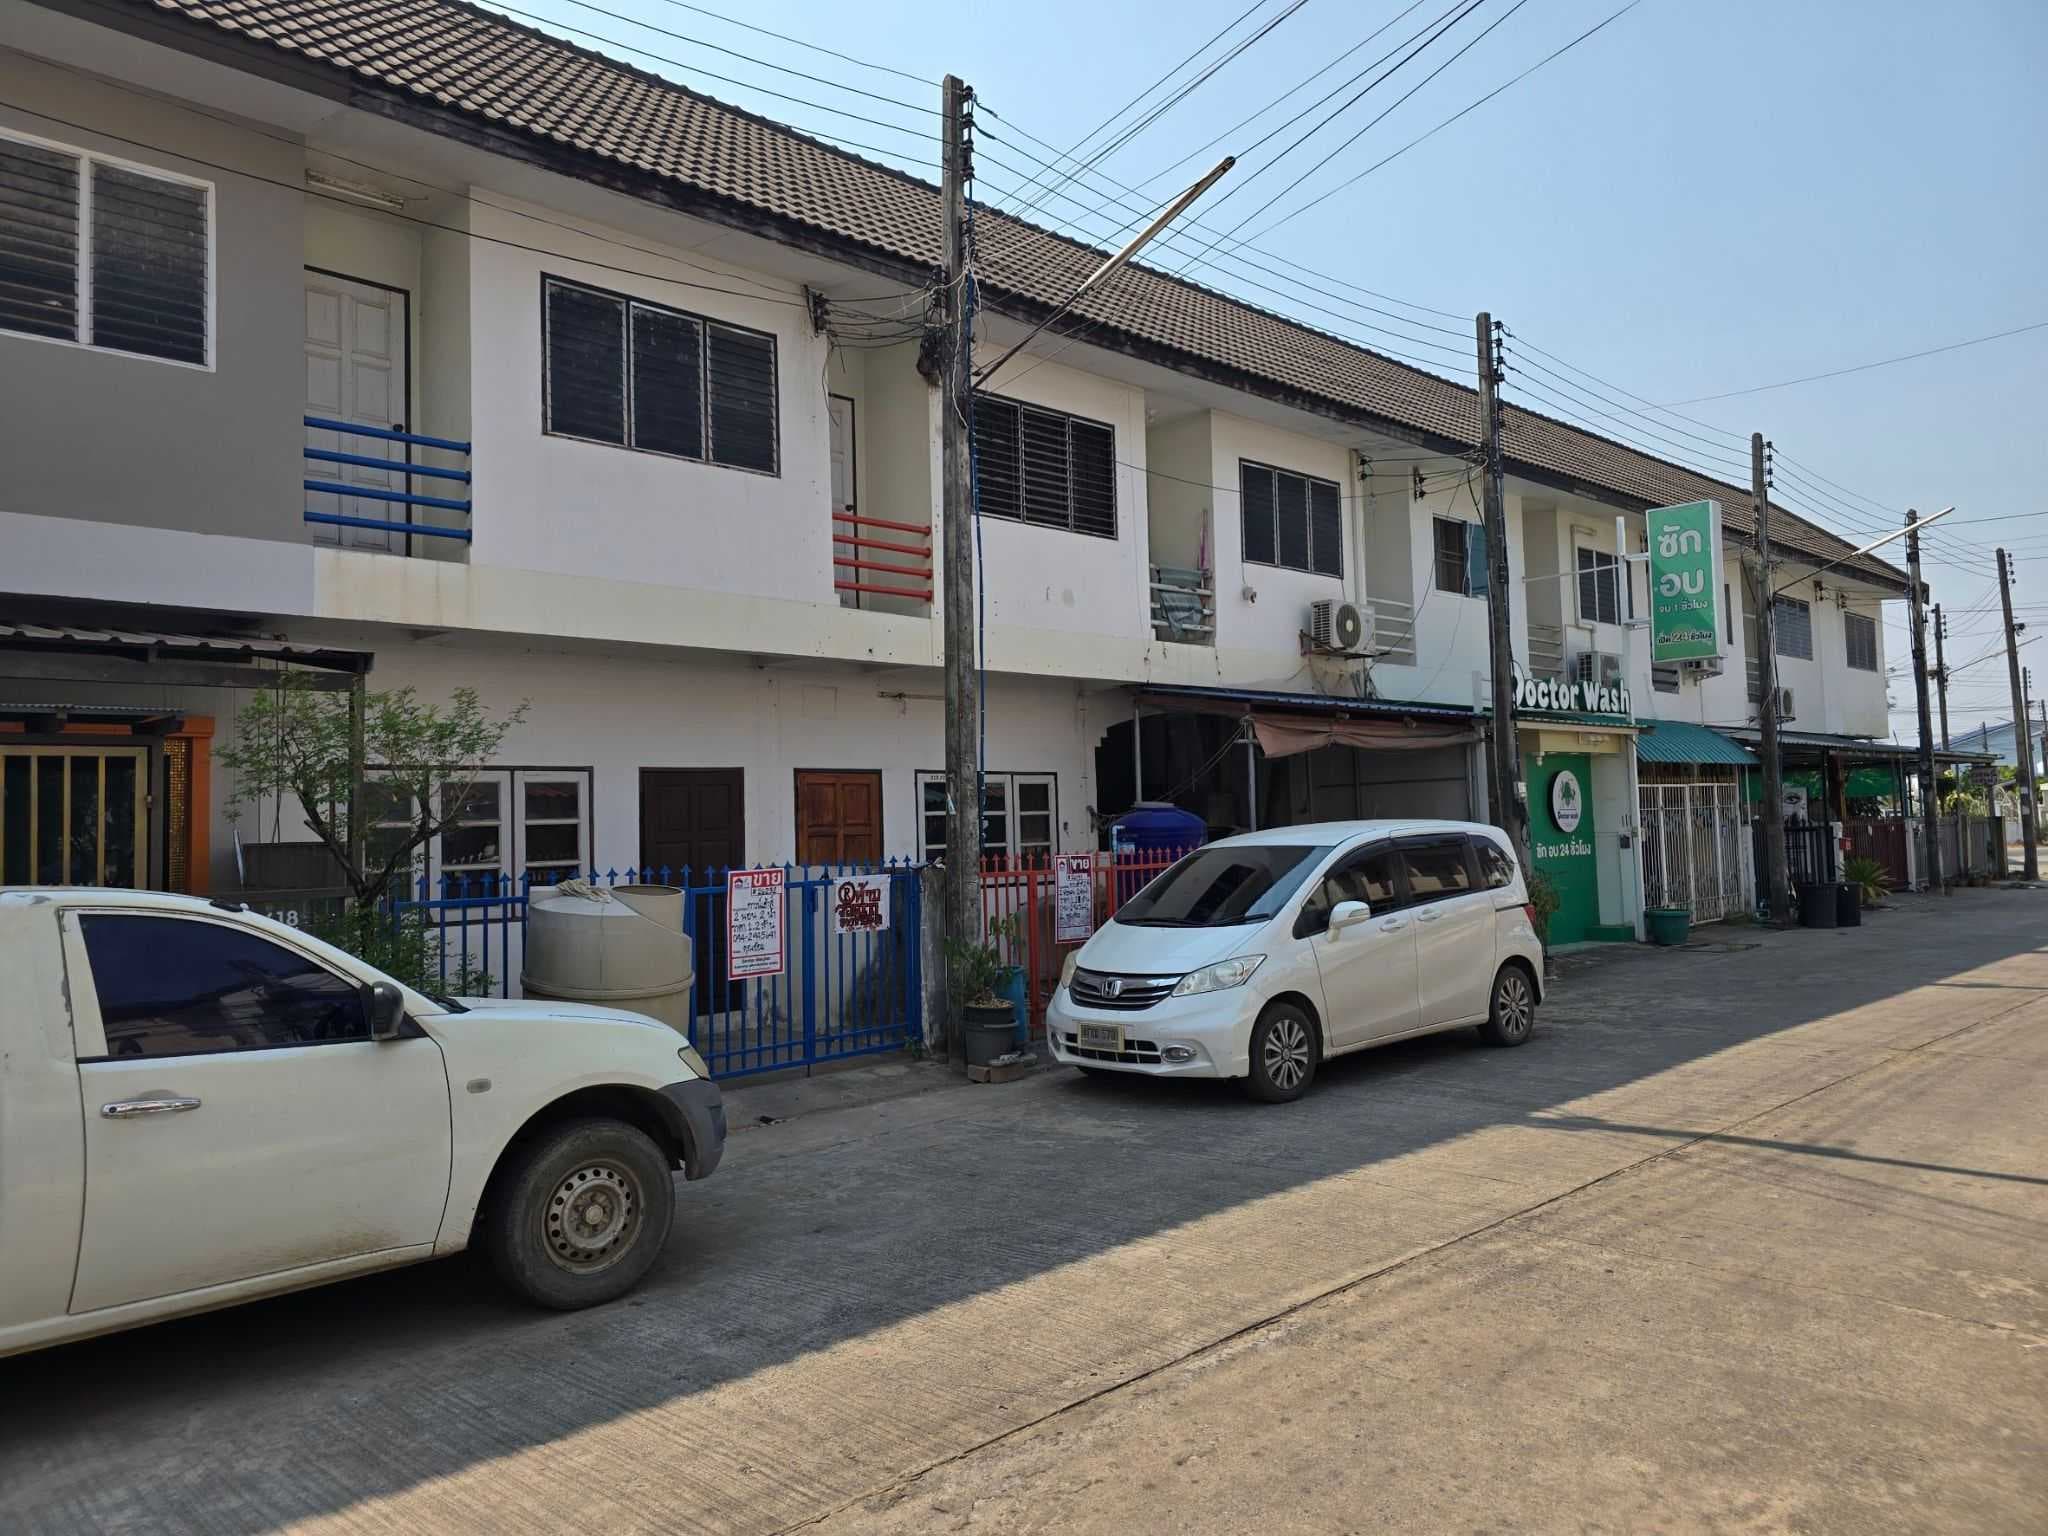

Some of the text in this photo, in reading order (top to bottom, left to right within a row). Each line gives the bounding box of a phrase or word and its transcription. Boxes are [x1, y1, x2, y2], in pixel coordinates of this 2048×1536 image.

[1660, 569, 1704, 597] อบ
[1583, 679, 1630, 713] Wash
[1560, 842, 1569, 857] 24
[1570, 835, 1591, 855] ชั่วโมง
[1071, 859, 1090, 870] ขาย
[753, 872, 781, 886] ขาย
[734, 911, 740, 921] 2
